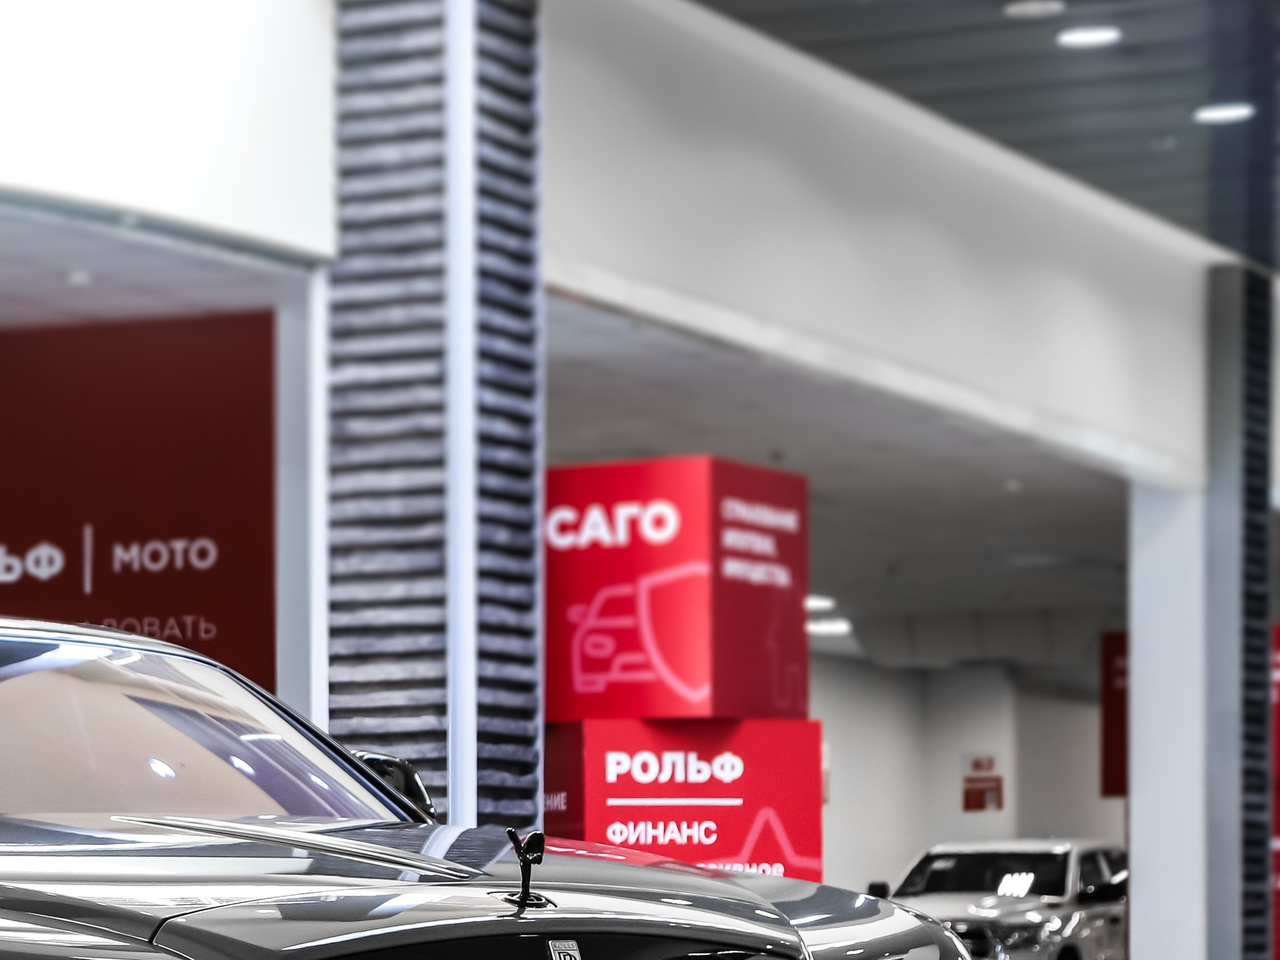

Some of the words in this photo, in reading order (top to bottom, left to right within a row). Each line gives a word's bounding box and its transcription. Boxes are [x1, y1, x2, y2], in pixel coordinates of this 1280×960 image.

[112, 537, 220, 573] МОТО
[605, 751, 745, 784] РОЛЬФ
[606, 821, 719, 846] ФИНАНС
